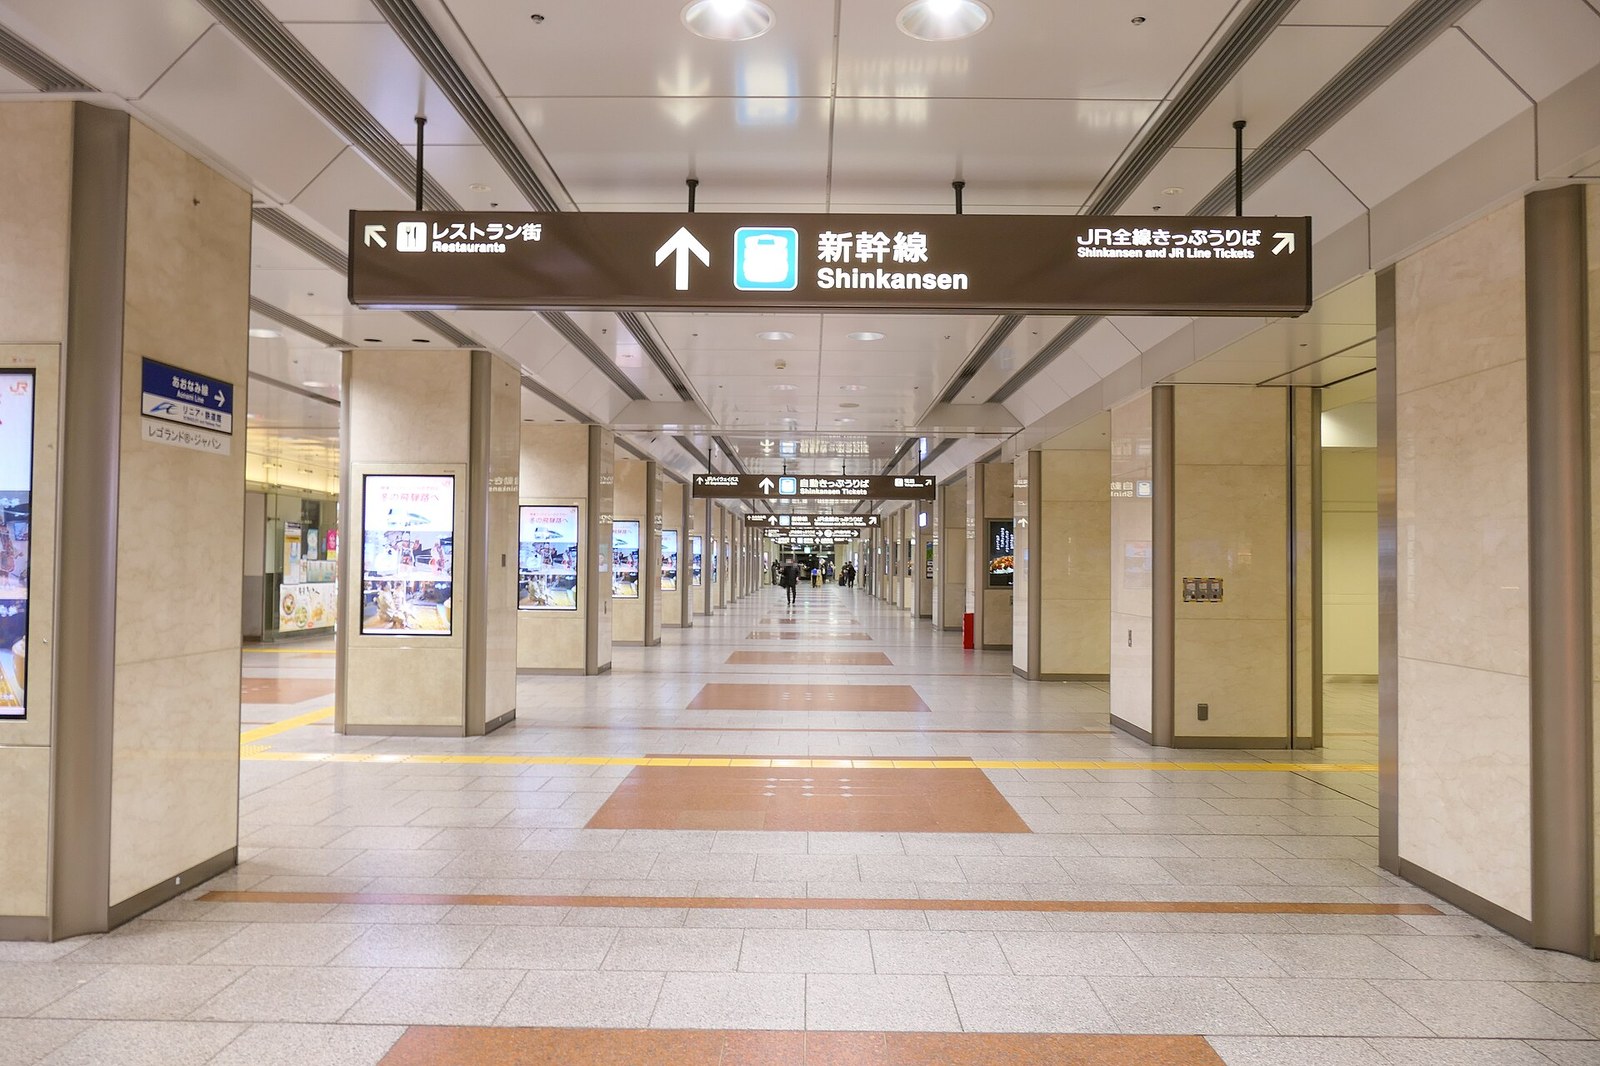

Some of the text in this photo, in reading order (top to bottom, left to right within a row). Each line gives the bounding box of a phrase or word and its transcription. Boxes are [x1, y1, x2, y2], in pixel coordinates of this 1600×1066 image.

[432, 222, 542, 242] レストラン街
[1077, 228, 1262, 247] JR全線きっぷうりば
[432, 241, 507, 254] Restaurants
[817, 230, 929, 263] 新幹線
[1077, 246, 1255, 260] Shinkansen and JR Line Tickets
[816, 267, 968, 290] Shinkansen
[172, 375, 208, 396] あおなみ線
